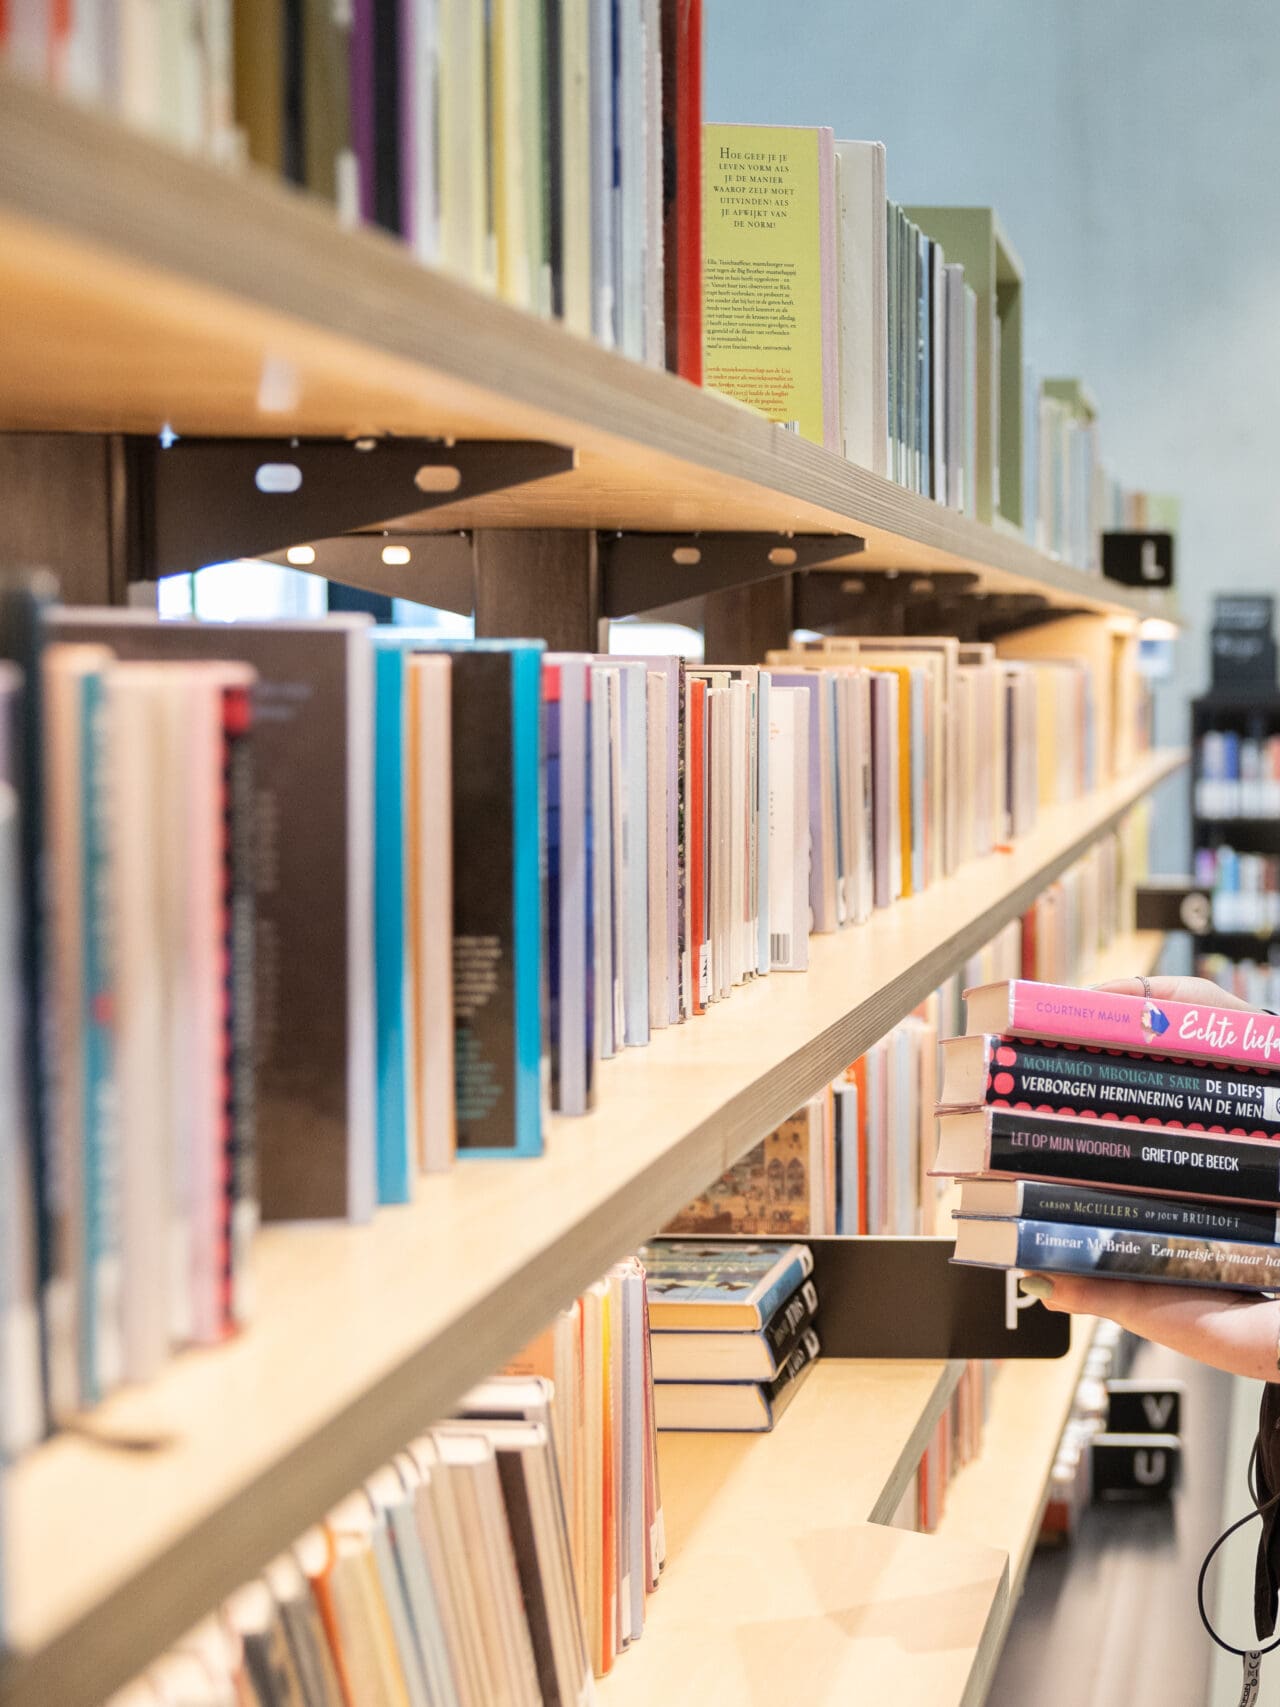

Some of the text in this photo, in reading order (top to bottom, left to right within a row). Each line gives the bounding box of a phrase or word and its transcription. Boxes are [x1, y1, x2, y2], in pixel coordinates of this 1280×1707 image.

[748, 164, 772, 172] VORM
[768, 154, 776, 163] JE
[779, 154, 788, 163] JE
[713, 185, 746, 193] WAAROP
[724, 174, 733, 184] JE
[749, 176, 783, 184] MANIER
[721, 208, 787, 219] JE AFWIJKT VAN
[774, 199, 789, 207] ALS
[733, 220, 745, 228] DE
[1036, 1001, 1095, 1020] COURTNEY
[1098, 1011, 1131, 1023] MAUM
[1178, 1010, 1238, 1049] Echte
[1099, 1065, 1164, 1086] MBOUGAR
[1169, 1074, 1200, 1091] SARR
[1206, 1079, 1222, 1093] DE
[1021, 1075, 1263, 1119] VERBORGEN HERINNERING VAN DE MEN
[1011, 1131, 1239, 1172] LET OP MIJN WOORDEN GRIET OP DE BEECK
[1039, 1200, 1240, 1229] CARSON McCULLERS OP JOUW BRUILOFT
[1035, 1232, 1083, 1249] Eimear
[1087, 1237, 1141, 1255] McBride
[1151, 1243, 1175, 1259] Een
[1176, 1246, 1215, 1266] meisje
[1216, 1251, 1227, 1262] is
[1229, 1253, 1263, 1266] maar
[1142, 1394, 1174, 1429] V
[1134, 1450, 1167, 1485] U
